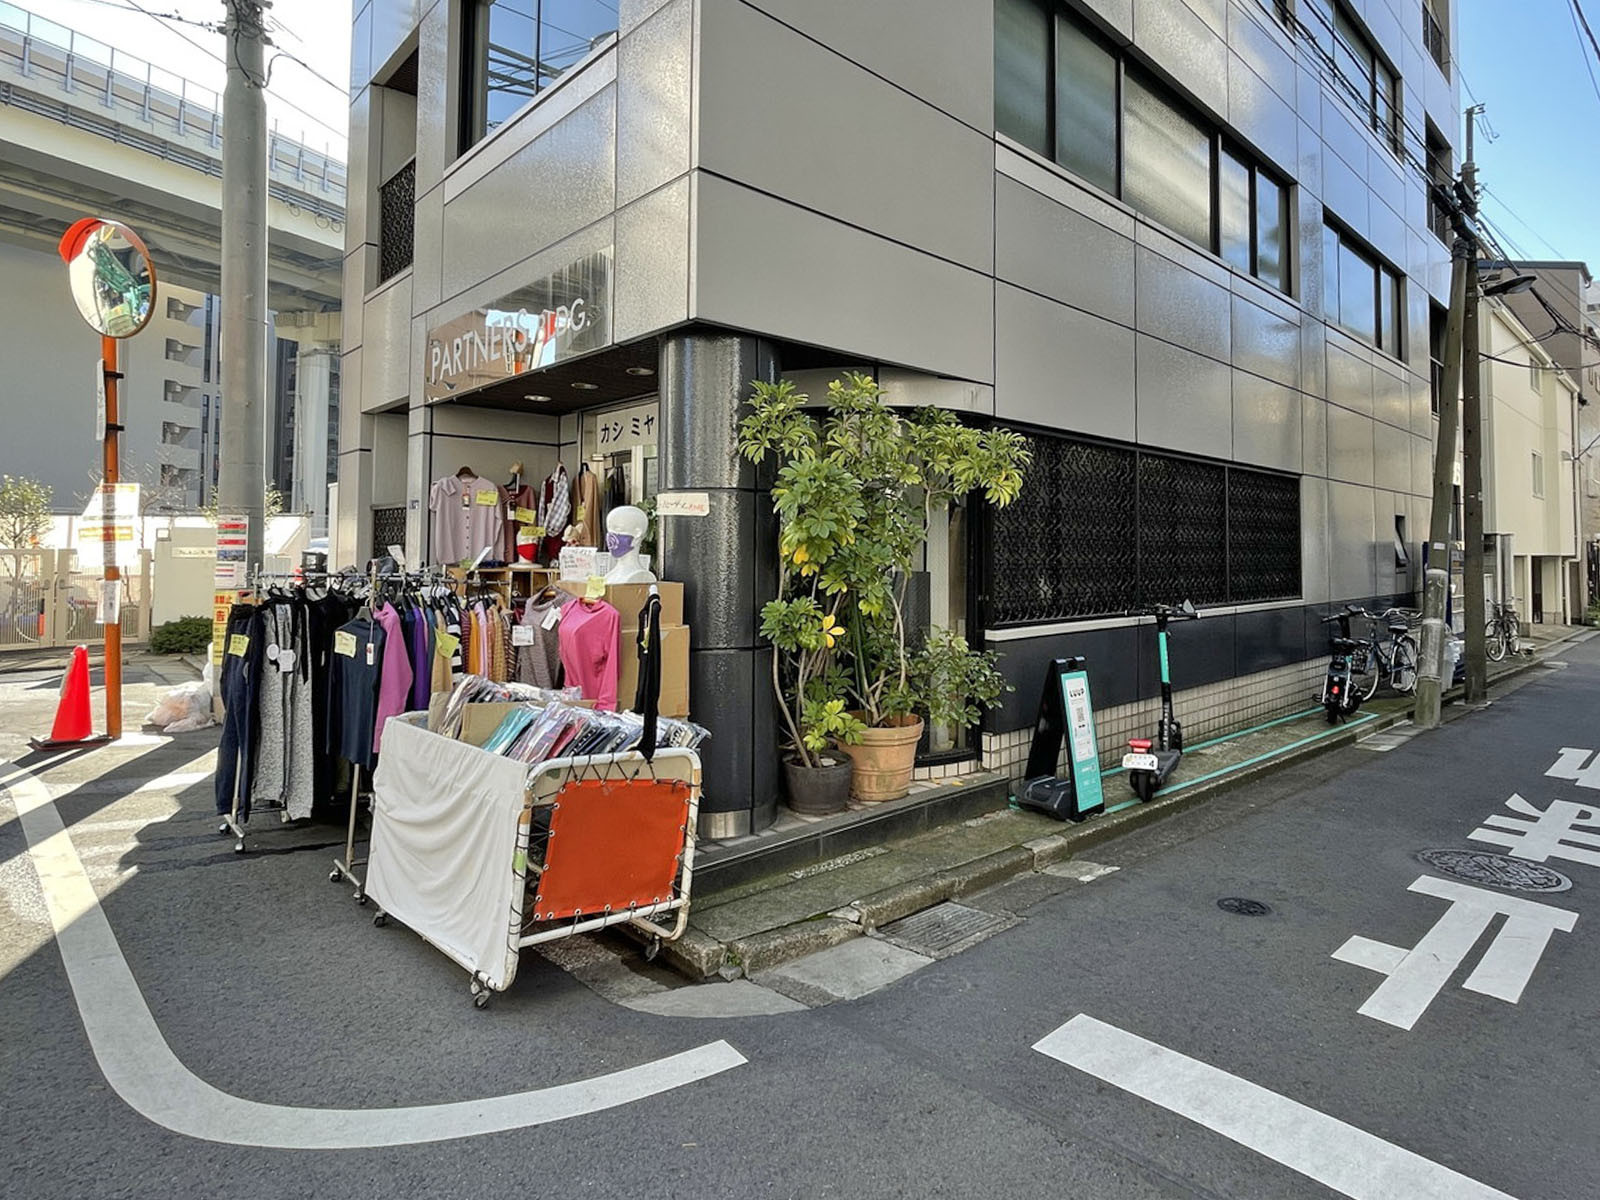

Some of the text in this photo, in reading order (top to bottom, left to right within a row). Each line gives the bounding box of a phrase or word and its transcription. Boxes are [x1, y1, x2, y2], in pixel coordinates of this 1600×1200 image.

[431, 308, 528, 384] PARTNERS
[600, 414, 655, 444] カシミヤ
